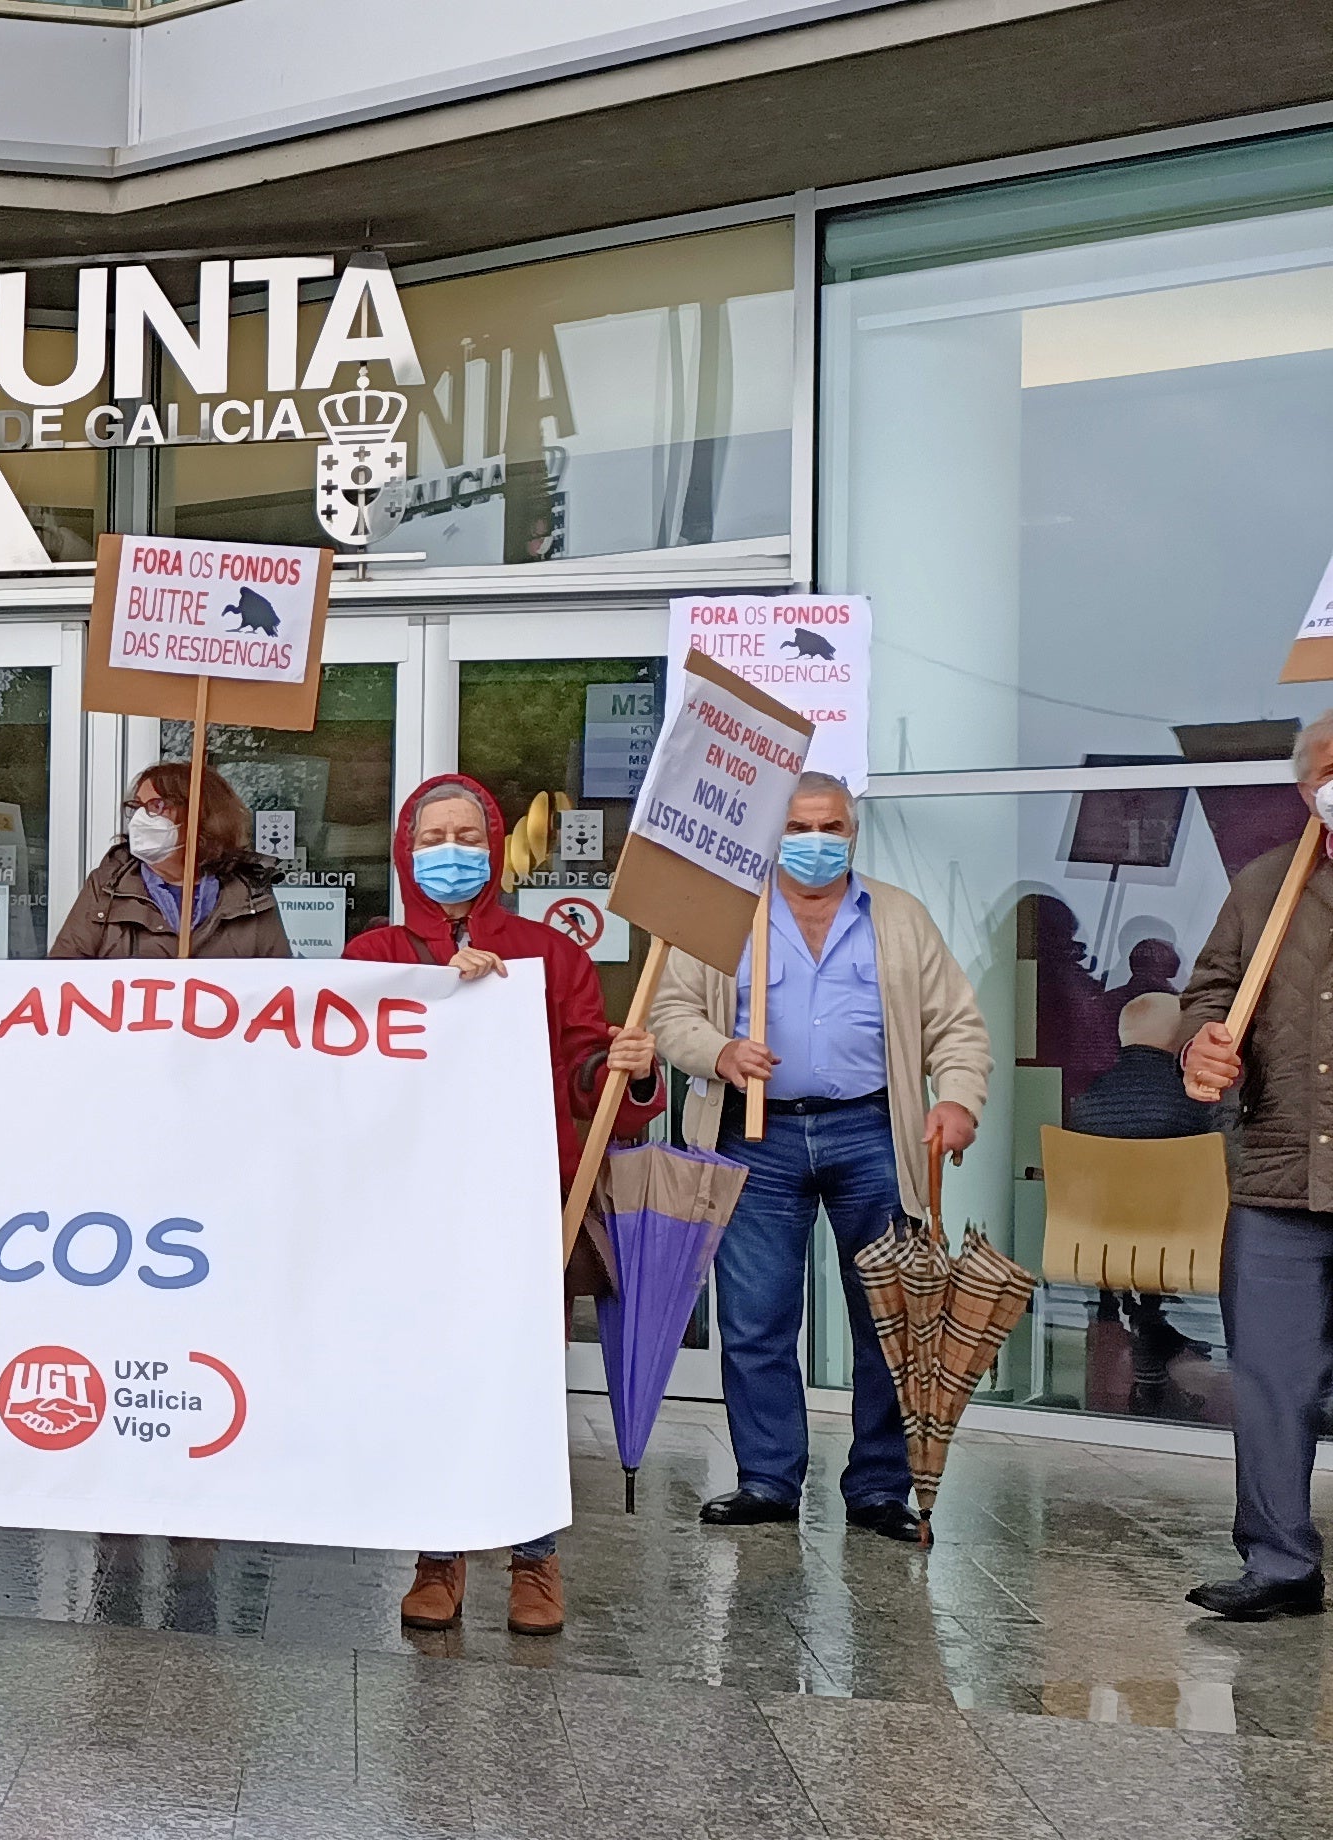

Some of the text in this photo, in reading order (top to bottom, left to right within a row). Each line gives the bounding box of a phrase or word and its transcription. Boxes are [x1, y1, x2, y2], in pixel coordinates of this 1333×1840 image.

[85, 400, 307, 449] GALICIA
[133, 547, 302, 586] FORA OS FONDOS
[128, 585, 210, 626] BUITRE
[690, 605, 850, 625] FORA OS FONDOS
[123, 630, 293, 670] DAS RESIDENCIAS
[690, 633, 766, 658] BUITRE
[699, 700, 741, 743] PRAZAS
[740, 725, 803, 776] PÚBLICAS
[706, 743, 757, 786] EN VIGO
[693, 778, 747, 827] NON ÁS
[647, 797, 769, 884] LISTAS DE ESPERA
[285, 872, 356, 886] GALICIA
[513, 872, 560, 886] UNTA
[565, 872, 589, 886] DE
[279, 901, 335, 911] TRINXIDO
[9, 1362, 91, 1405] UGT
[114, 1360, 169, 1381] UXP
[113, 1387, 202, 1411] Galicia
[112, 1415, 171, 1443] Vigo
